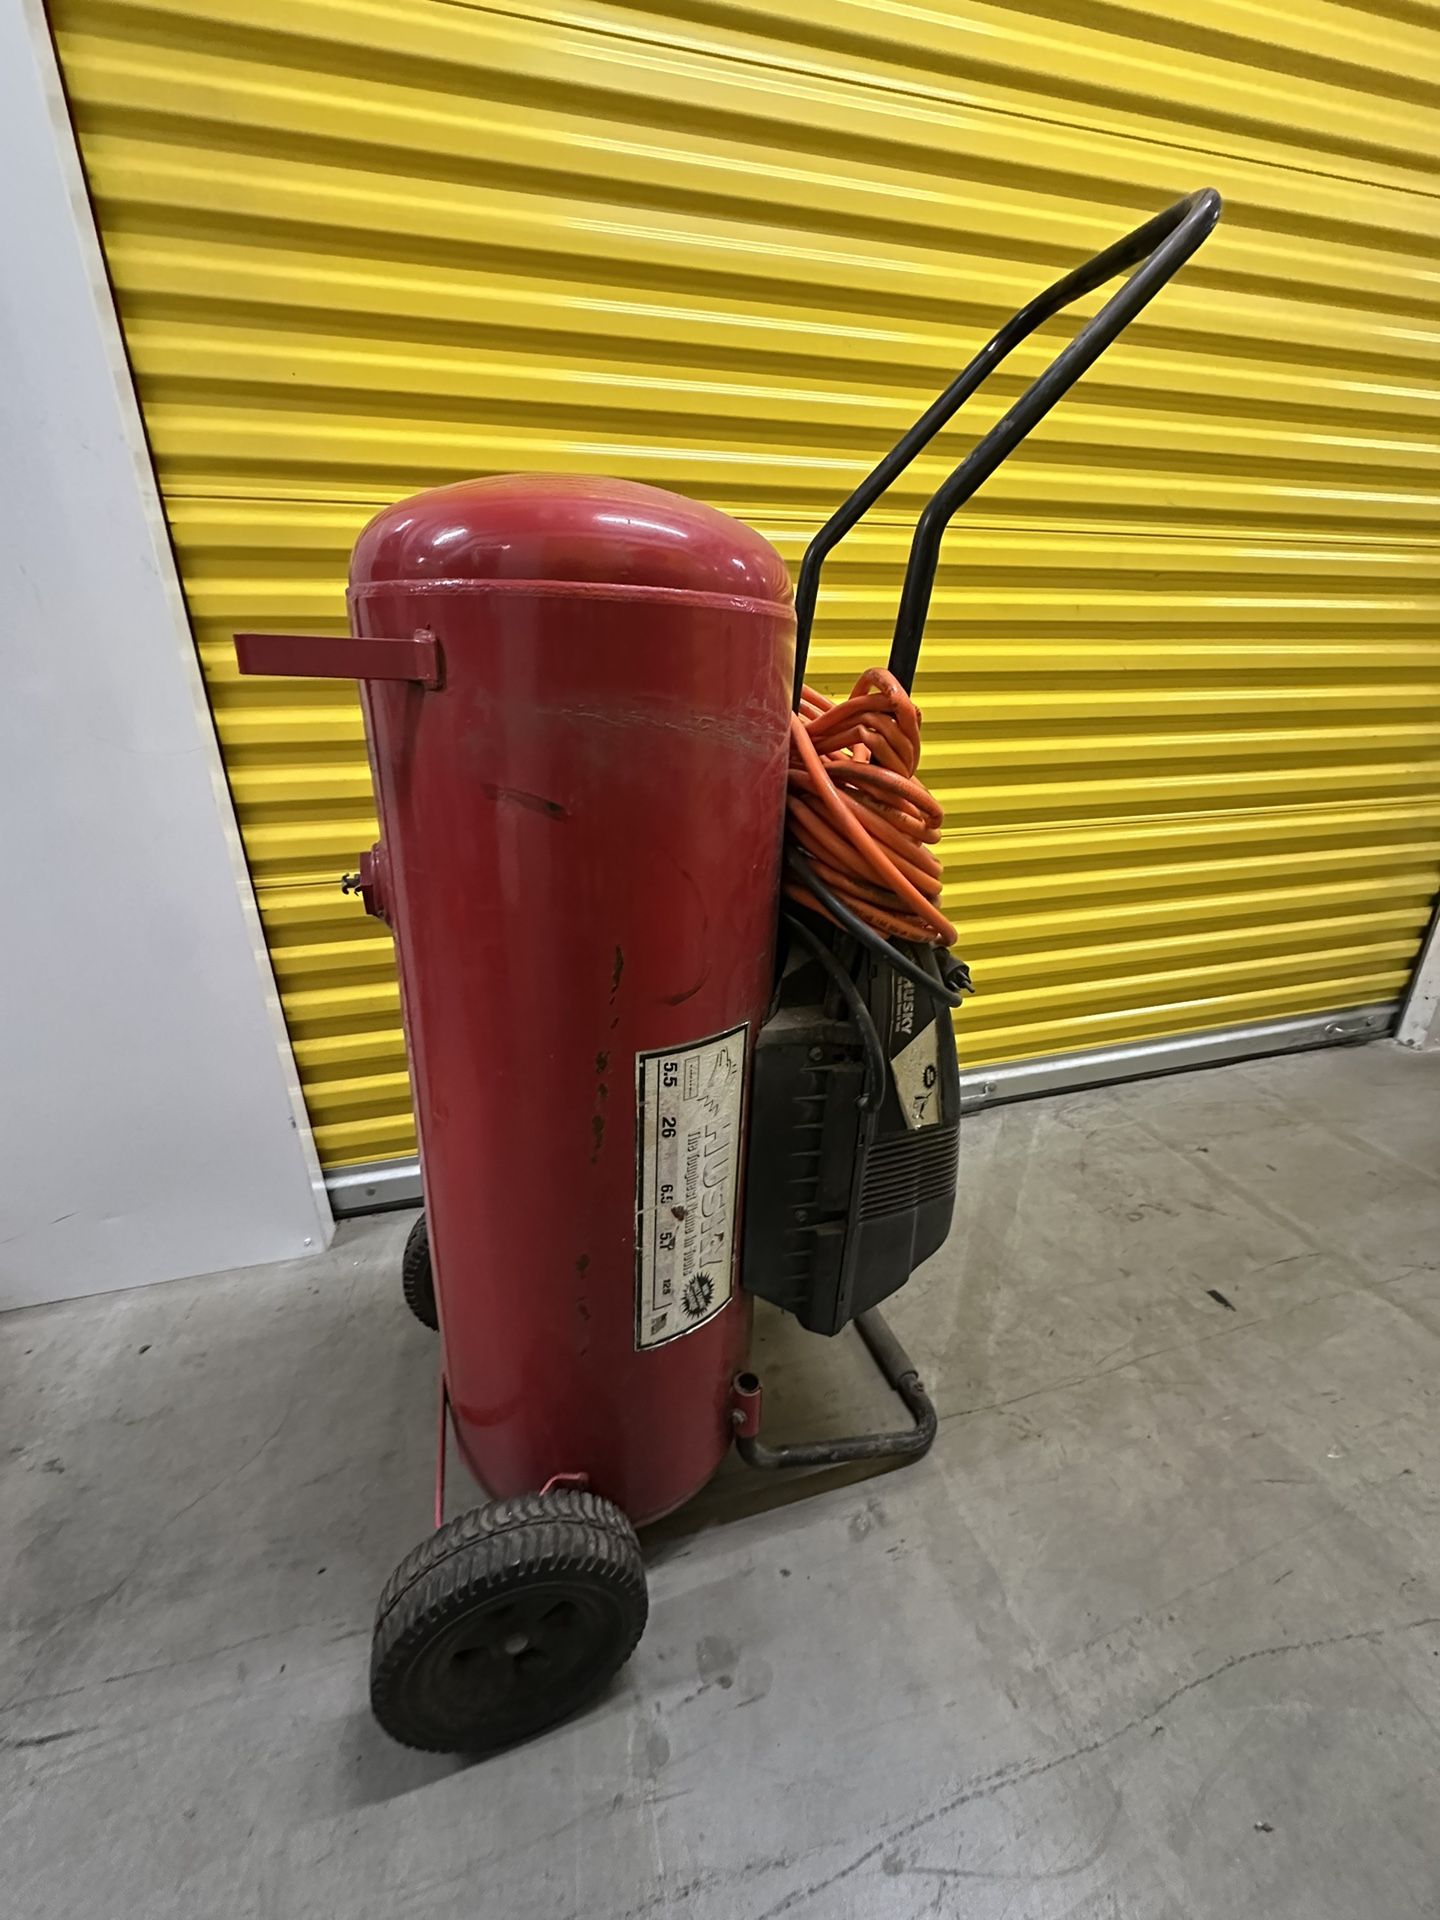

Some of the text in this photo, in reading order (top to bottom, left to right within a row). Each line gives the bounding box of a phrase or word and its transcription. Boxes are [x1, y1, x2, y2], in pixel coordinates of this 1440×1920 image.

[663, 1062, 678, 1088] 5.5
[661, 1116, 677, 1139] 26
[687, 1131, 701, 1152] The
[685, 1154, 700, 1200] Toughest
[700, 1119, 732, 1268] HUSKY
